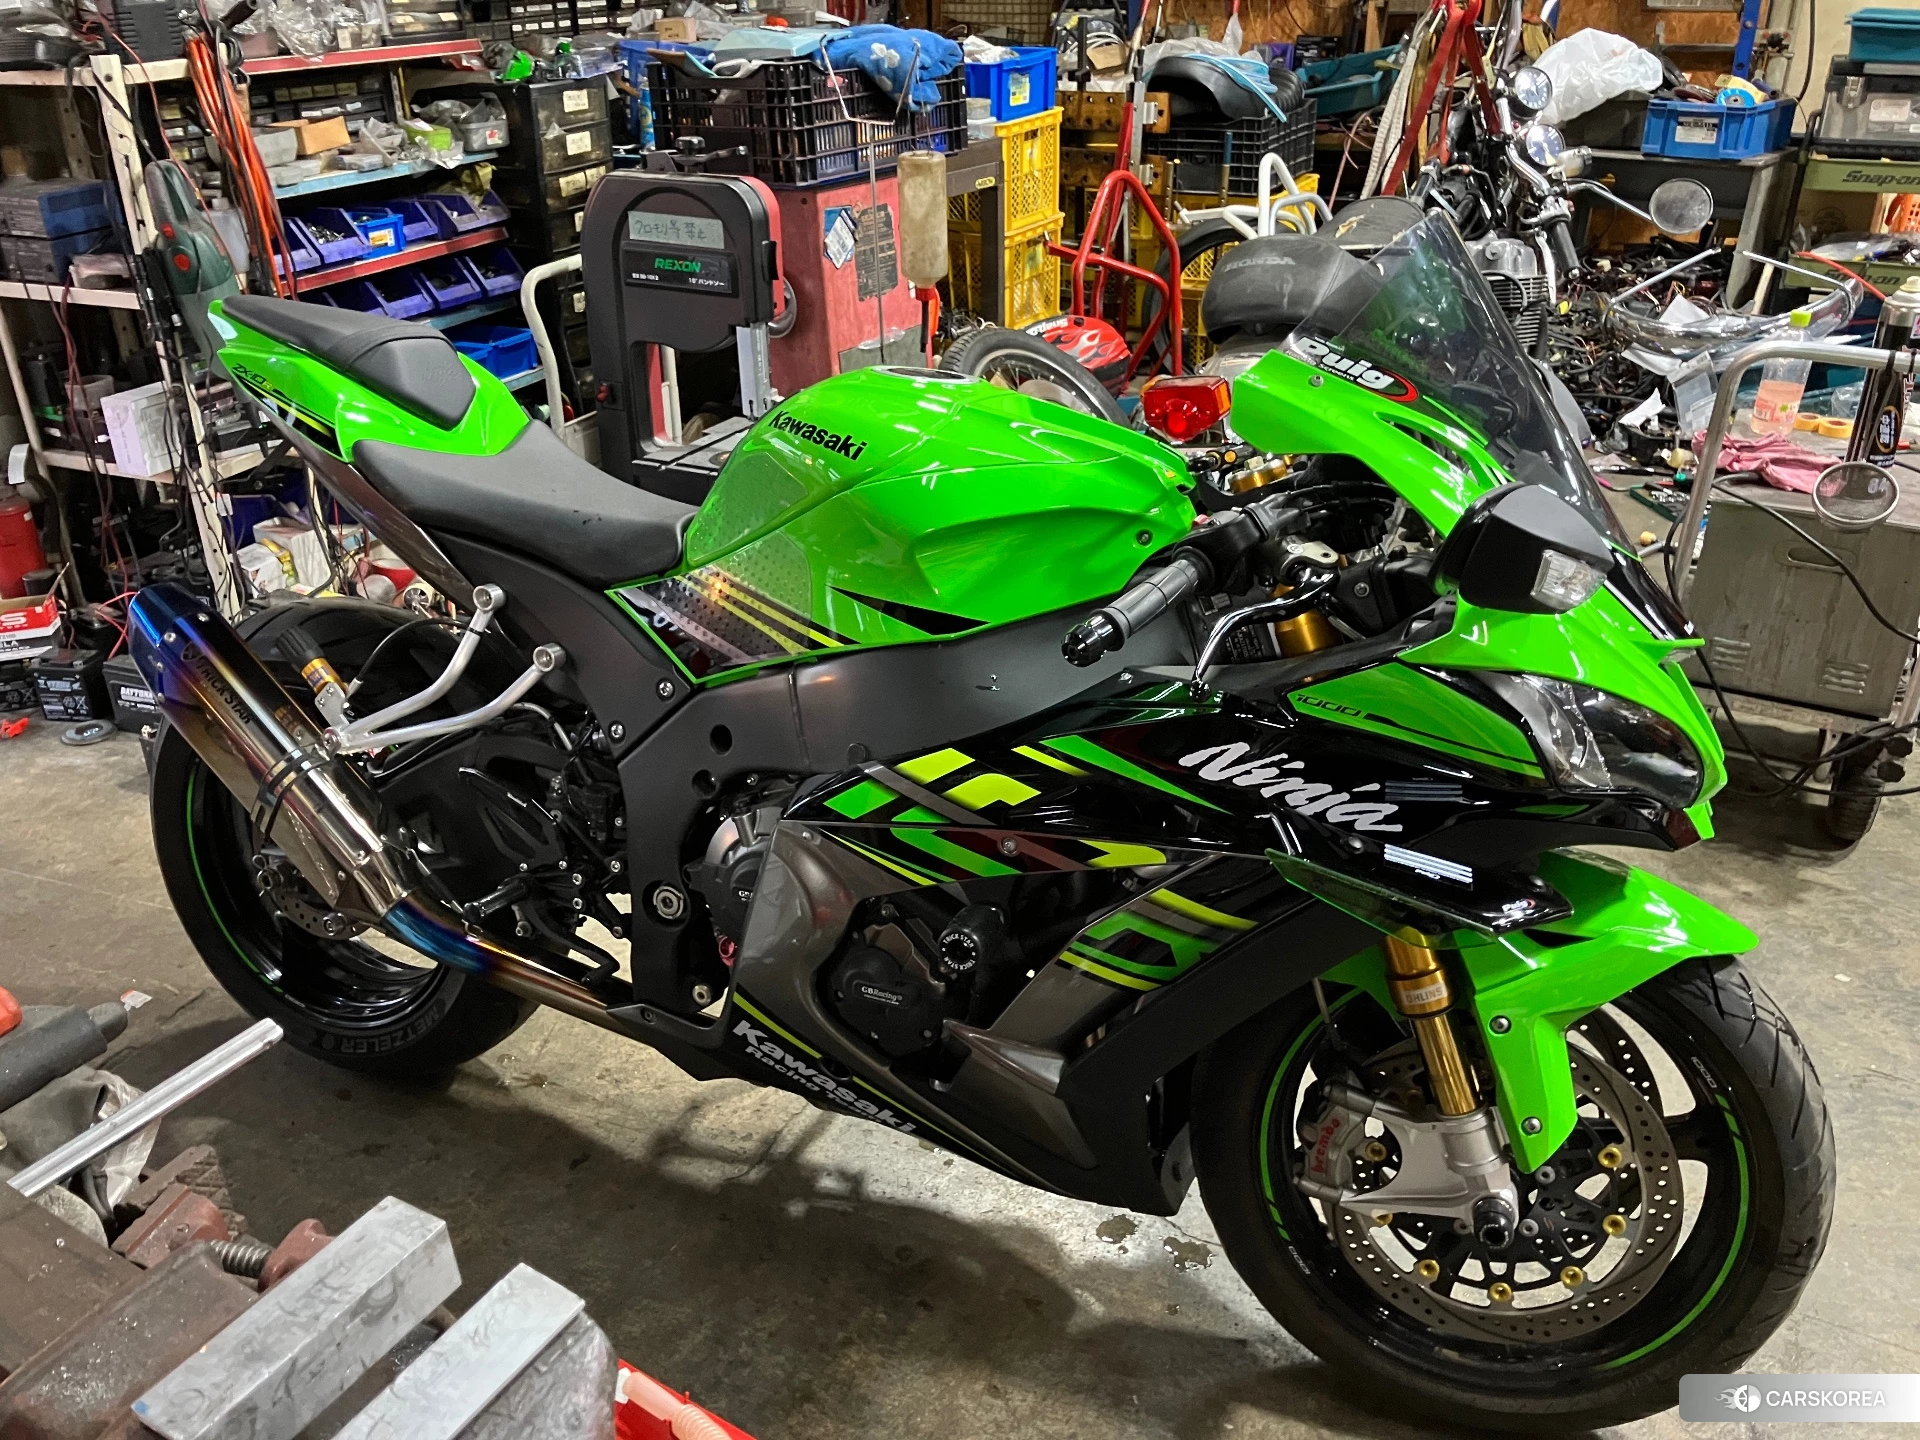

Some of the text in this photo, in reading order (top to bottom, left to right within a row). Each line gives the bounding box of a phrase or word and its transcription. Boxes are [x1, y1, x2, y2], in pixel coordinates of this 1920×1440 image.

[654, 257, 702, 273] REXON
[1298, 336, 1395, 389] Puig
[768, 410, 868, 461] Kawasaki
[1296, 694, 1362, 717] 1000
[1178, 741, 1403, 832] Ninja
[340, 1004, 440, 1053] METZELER
[732, 1019, 917, 1132] Kawasaki
[744, 1045, 821, 1092] Racing
[1311, 1118, 1341, 1173] brembo
